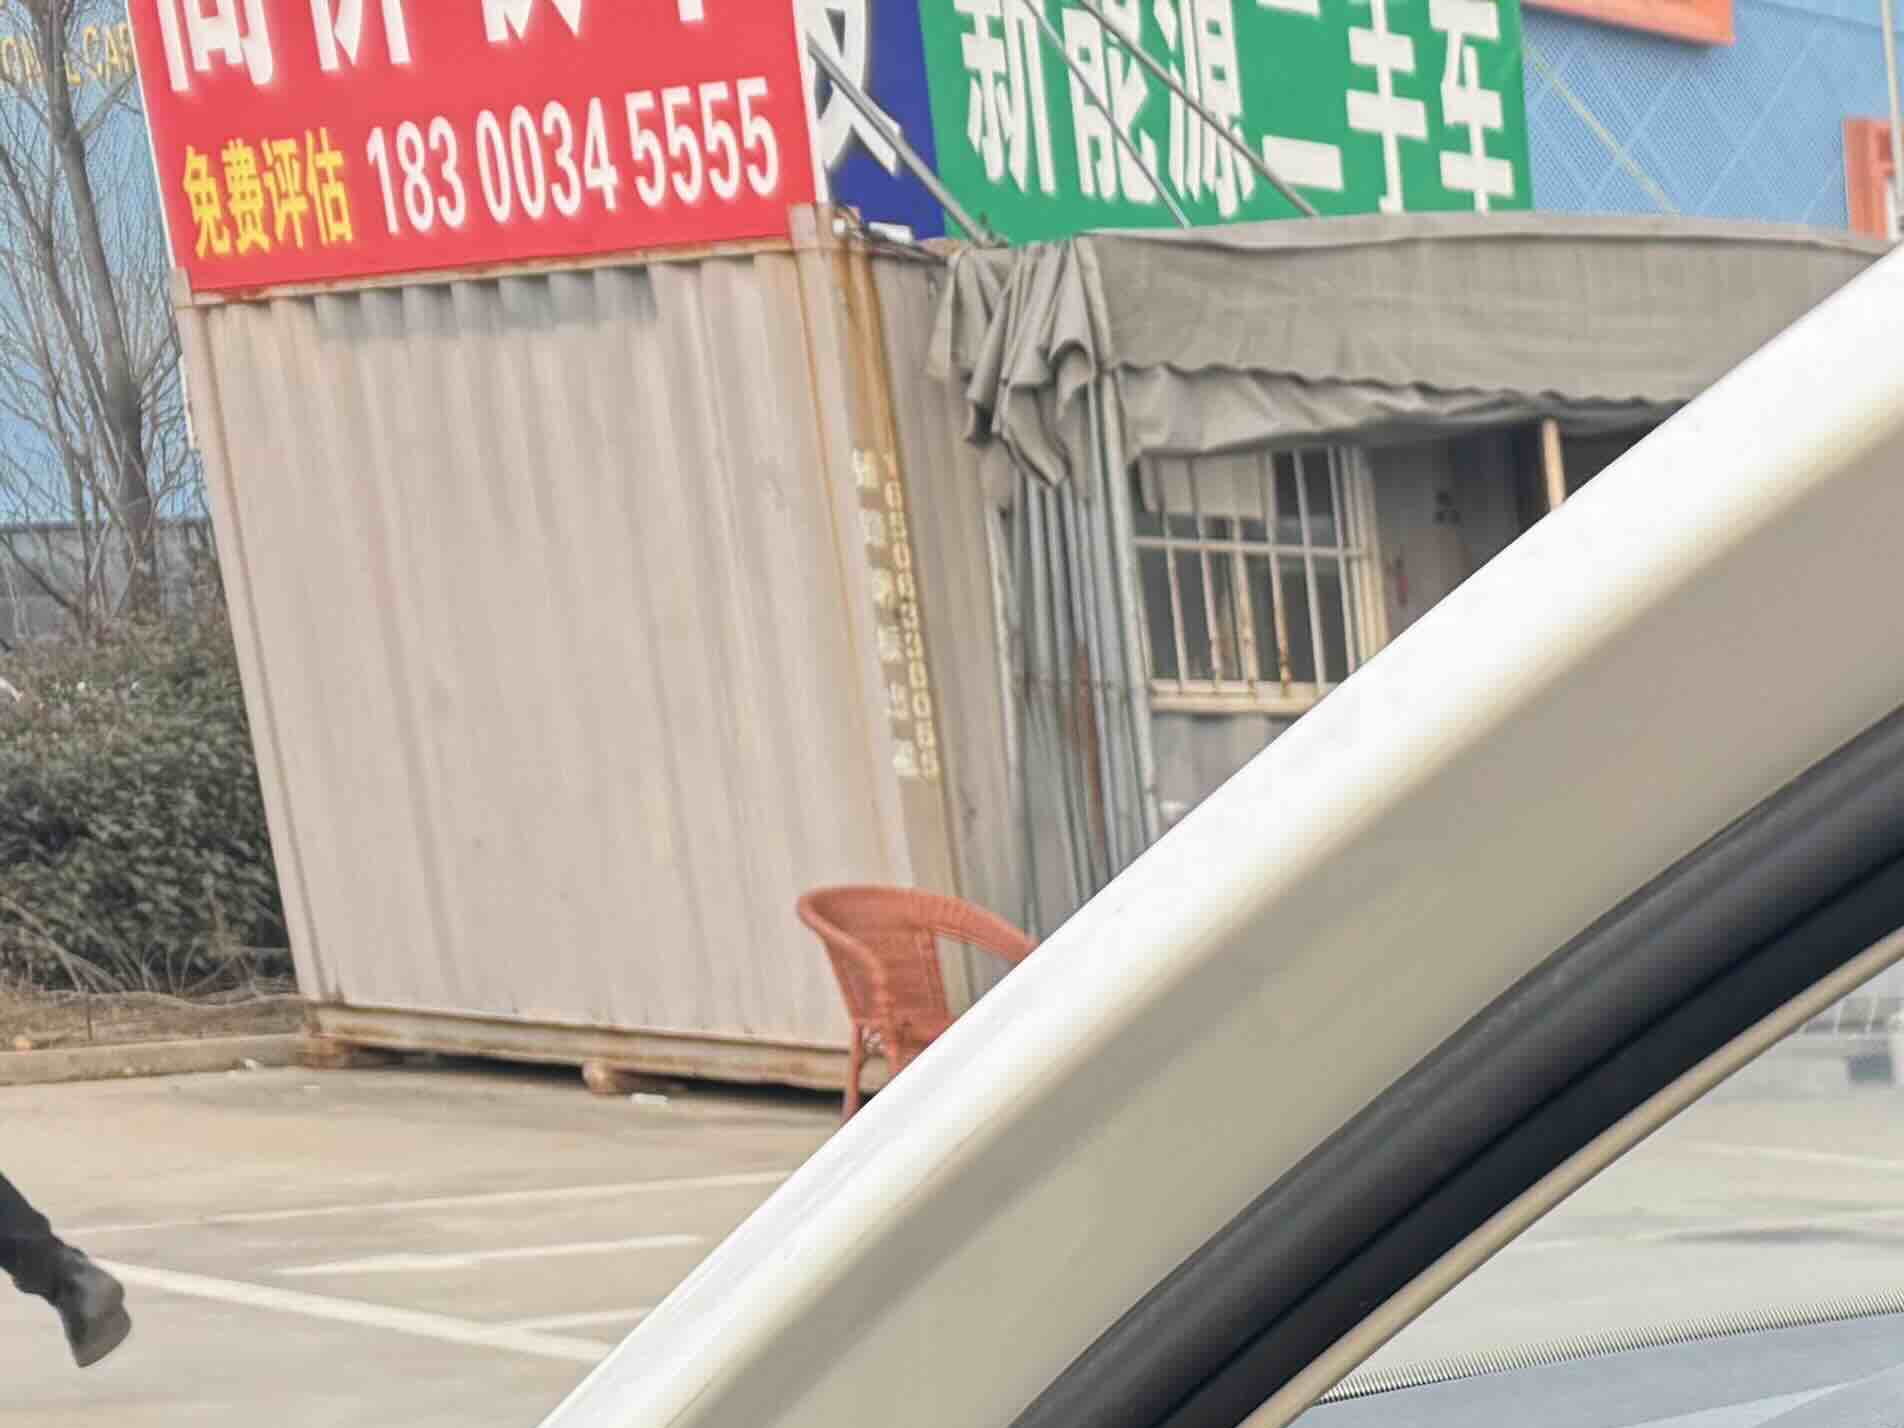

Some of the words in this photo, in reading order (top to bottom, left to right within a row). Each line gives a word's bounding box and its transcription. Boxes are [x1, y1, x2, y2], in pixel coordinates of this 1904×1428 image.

[183, 128, 353, 258] 免费评估
[366, 114, 467, 235] 183
[475, 96, 619, 218] 0034
[627, 76, 780, 206] 5555
